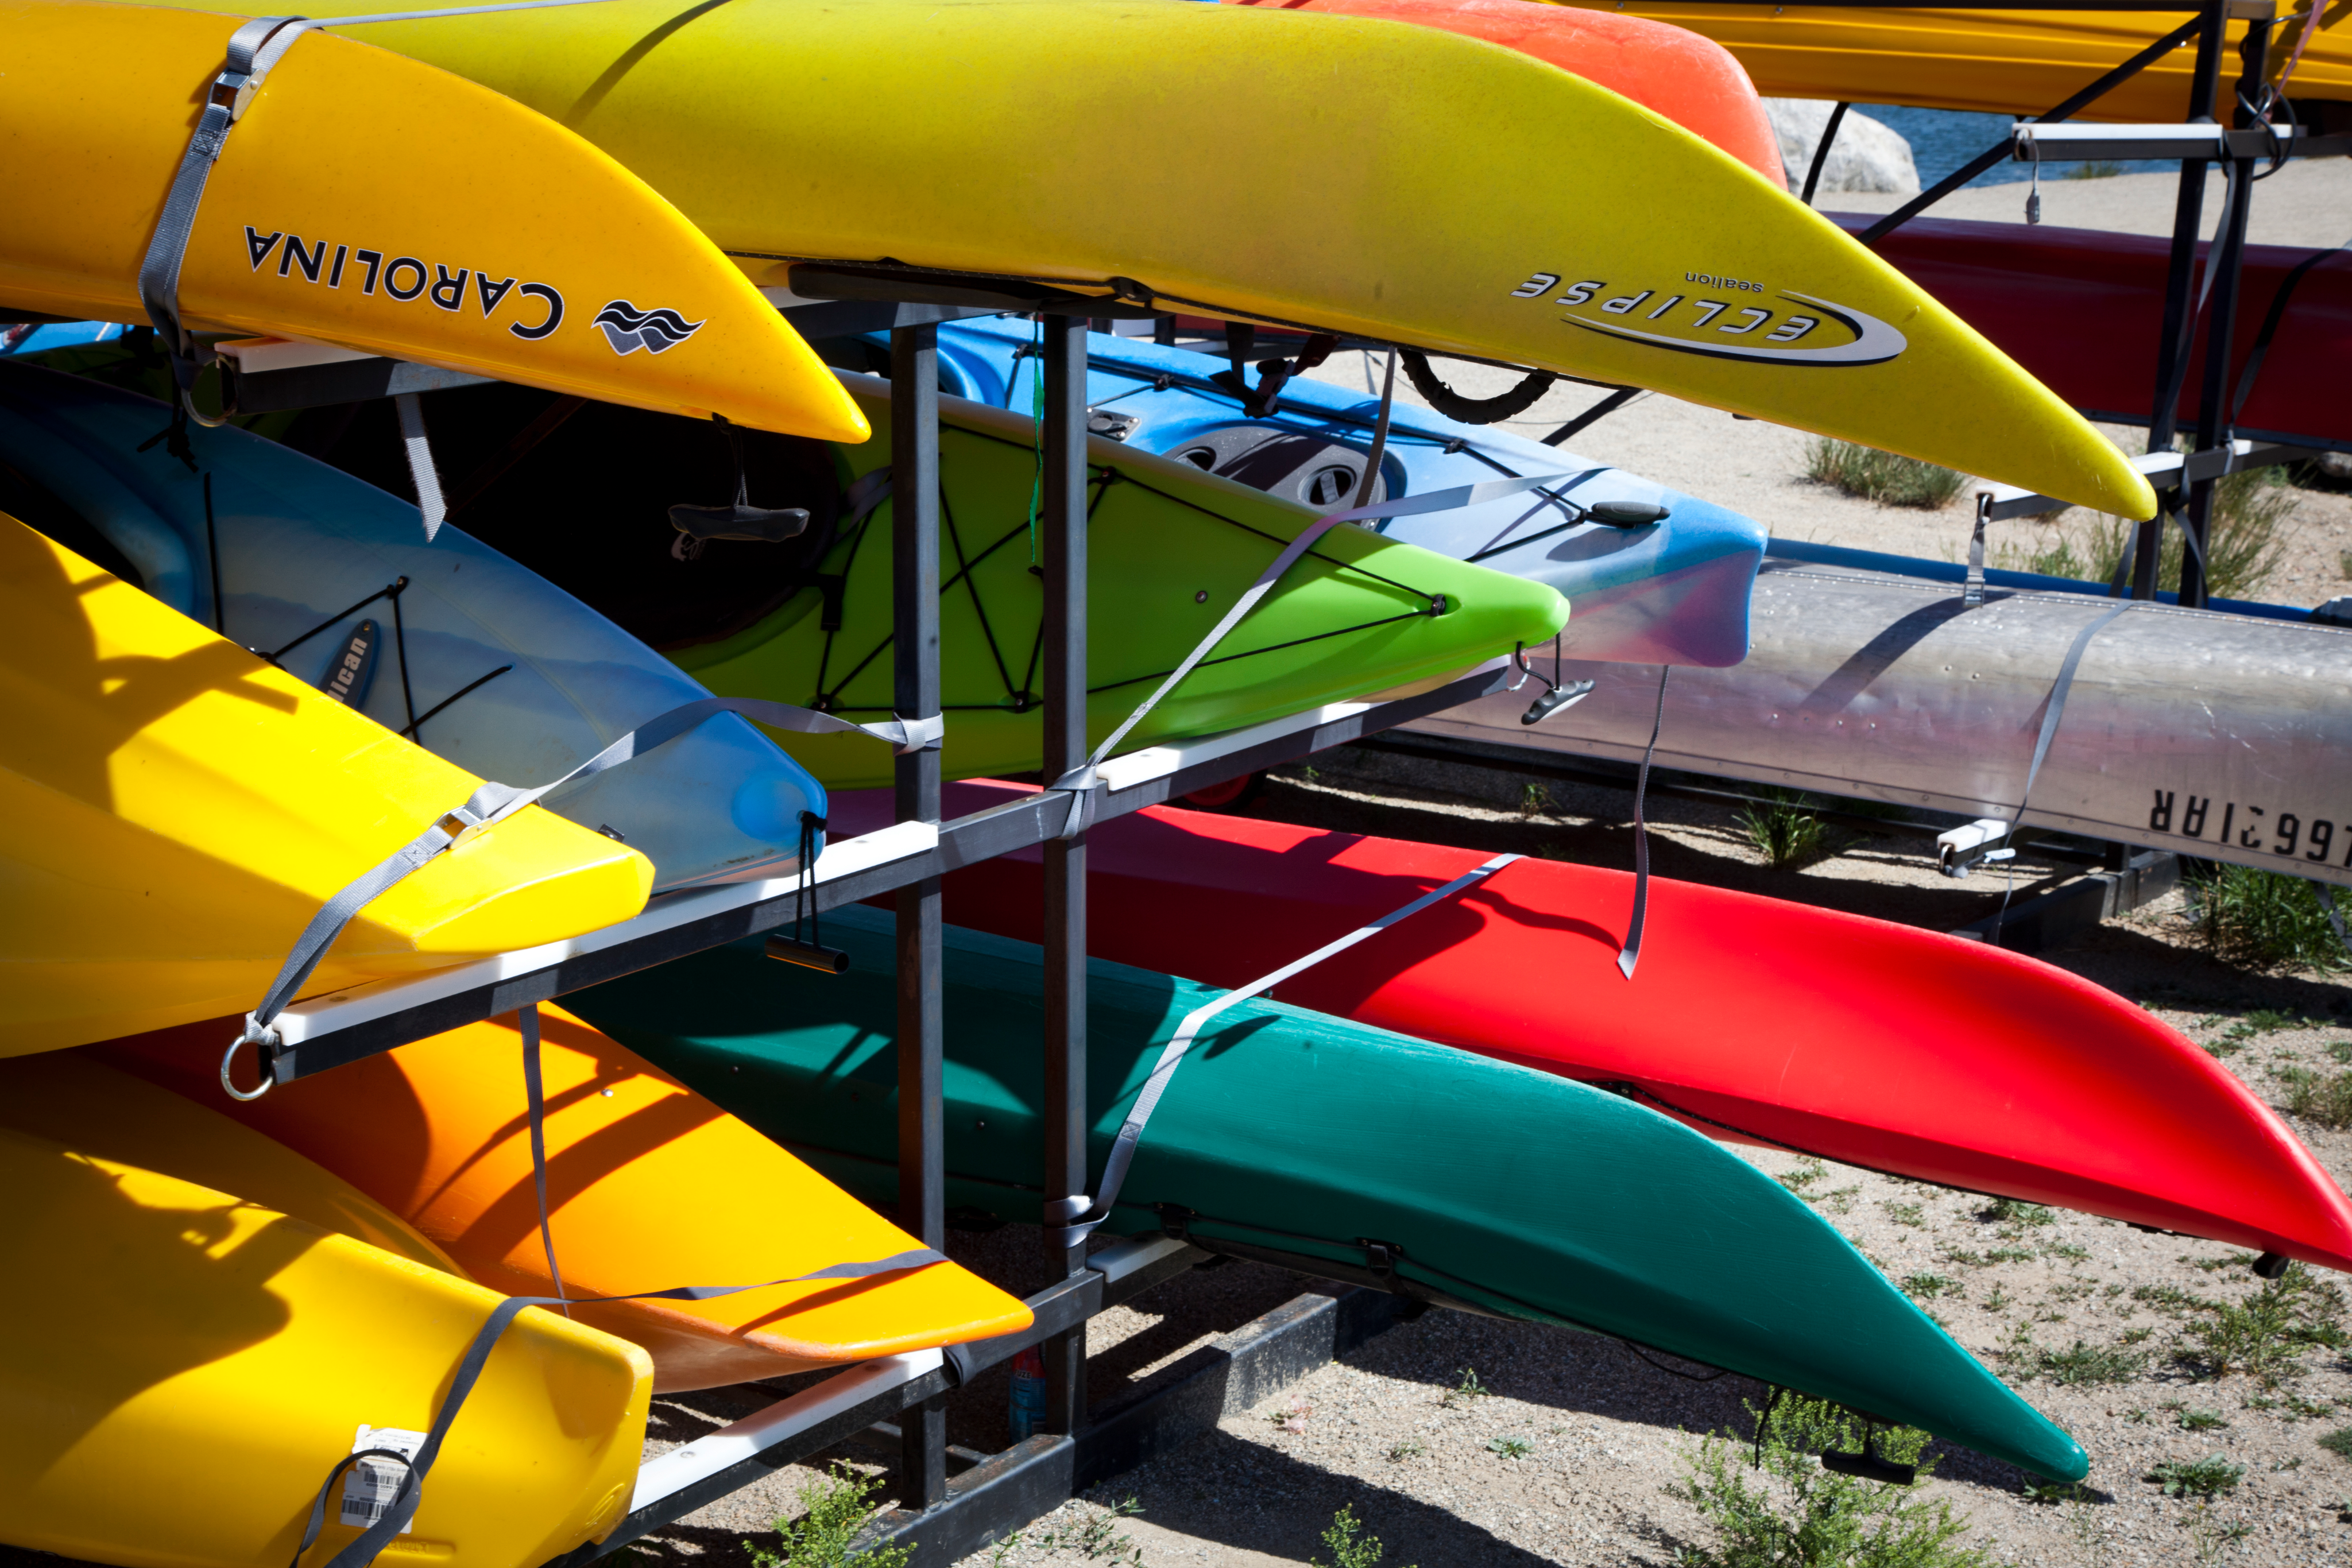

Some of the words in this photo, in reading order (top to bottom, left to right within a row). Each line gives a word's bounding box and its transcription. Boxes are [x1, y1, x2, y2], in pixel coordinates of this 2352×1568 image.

[243, 225, 566, 341] CAROLINA
[1509, 272, 1820, 343] ECLIPSE
[1685, 271, 1765, 292] sealion
